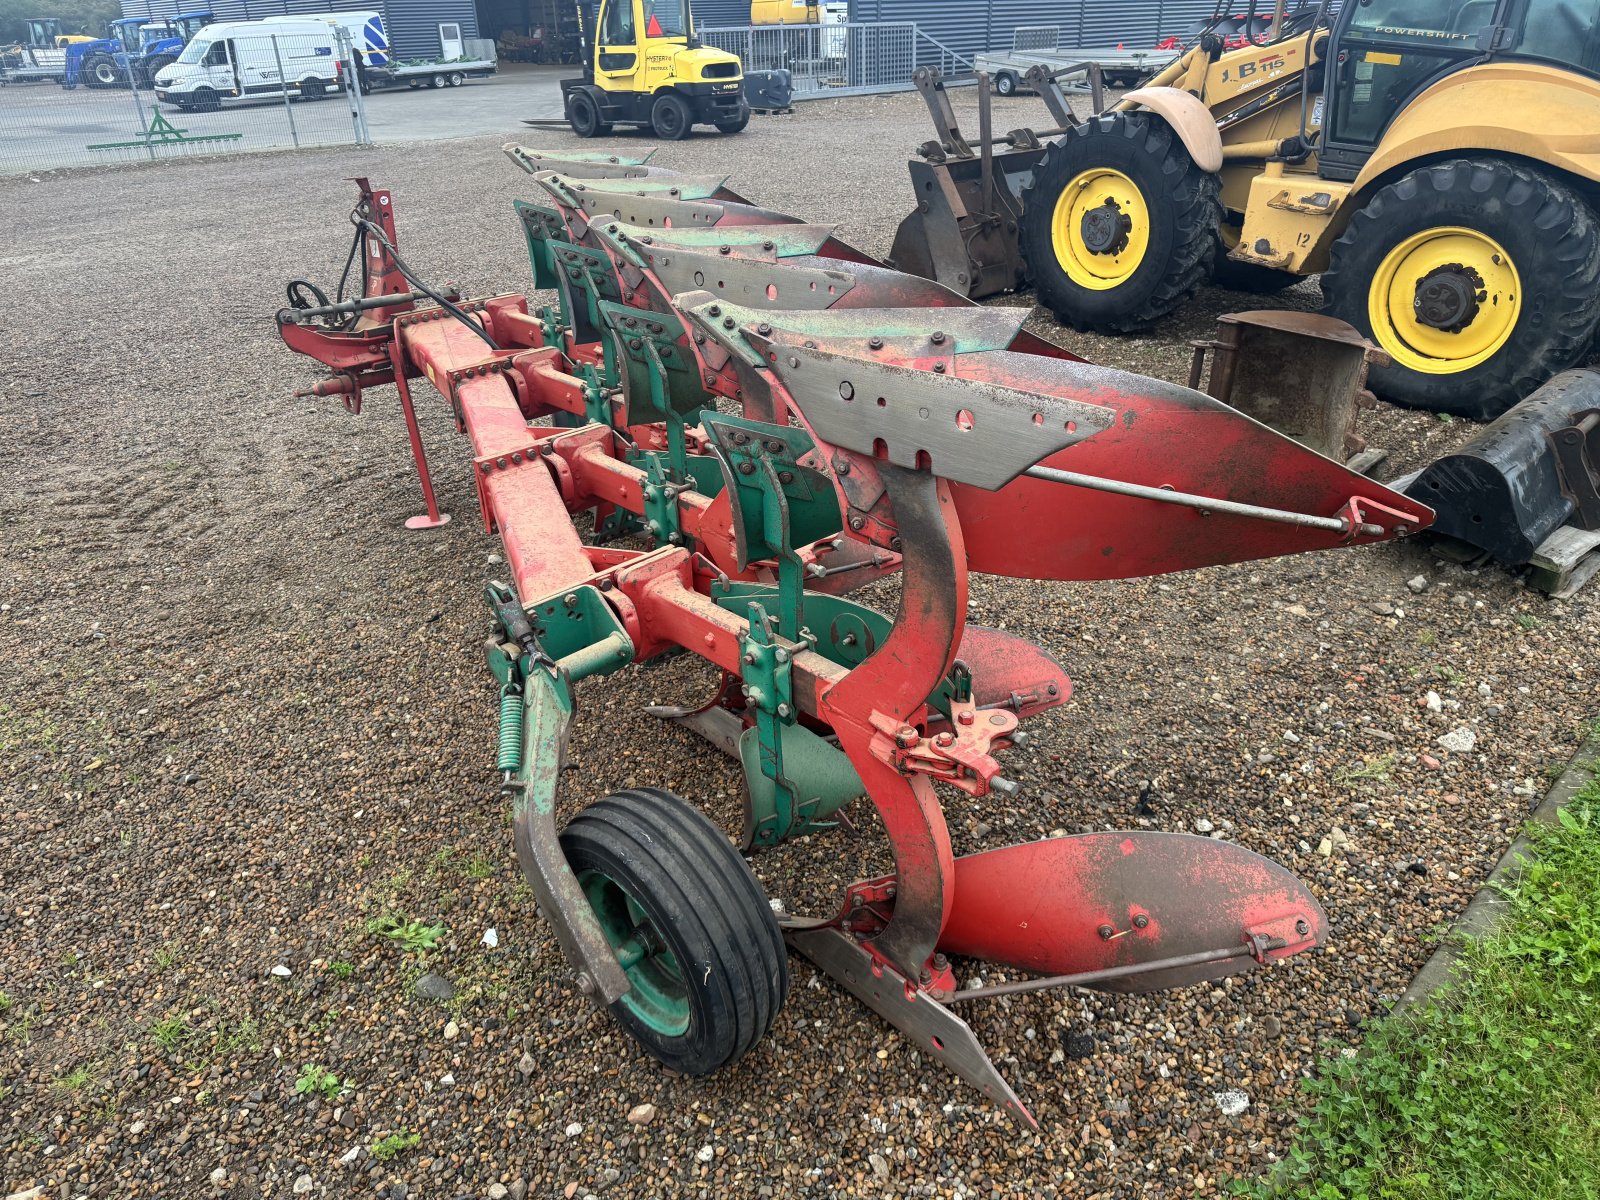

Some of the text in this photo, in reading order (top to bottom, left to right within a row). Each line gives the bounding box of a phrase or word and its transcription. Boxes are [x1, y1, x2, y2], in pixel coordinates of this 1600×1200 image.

[1374, 26, 1469, 40] POWERSHIFT
[1260, 58, 1285, 72] 115
[1296, 232, 1310, 248] 12
